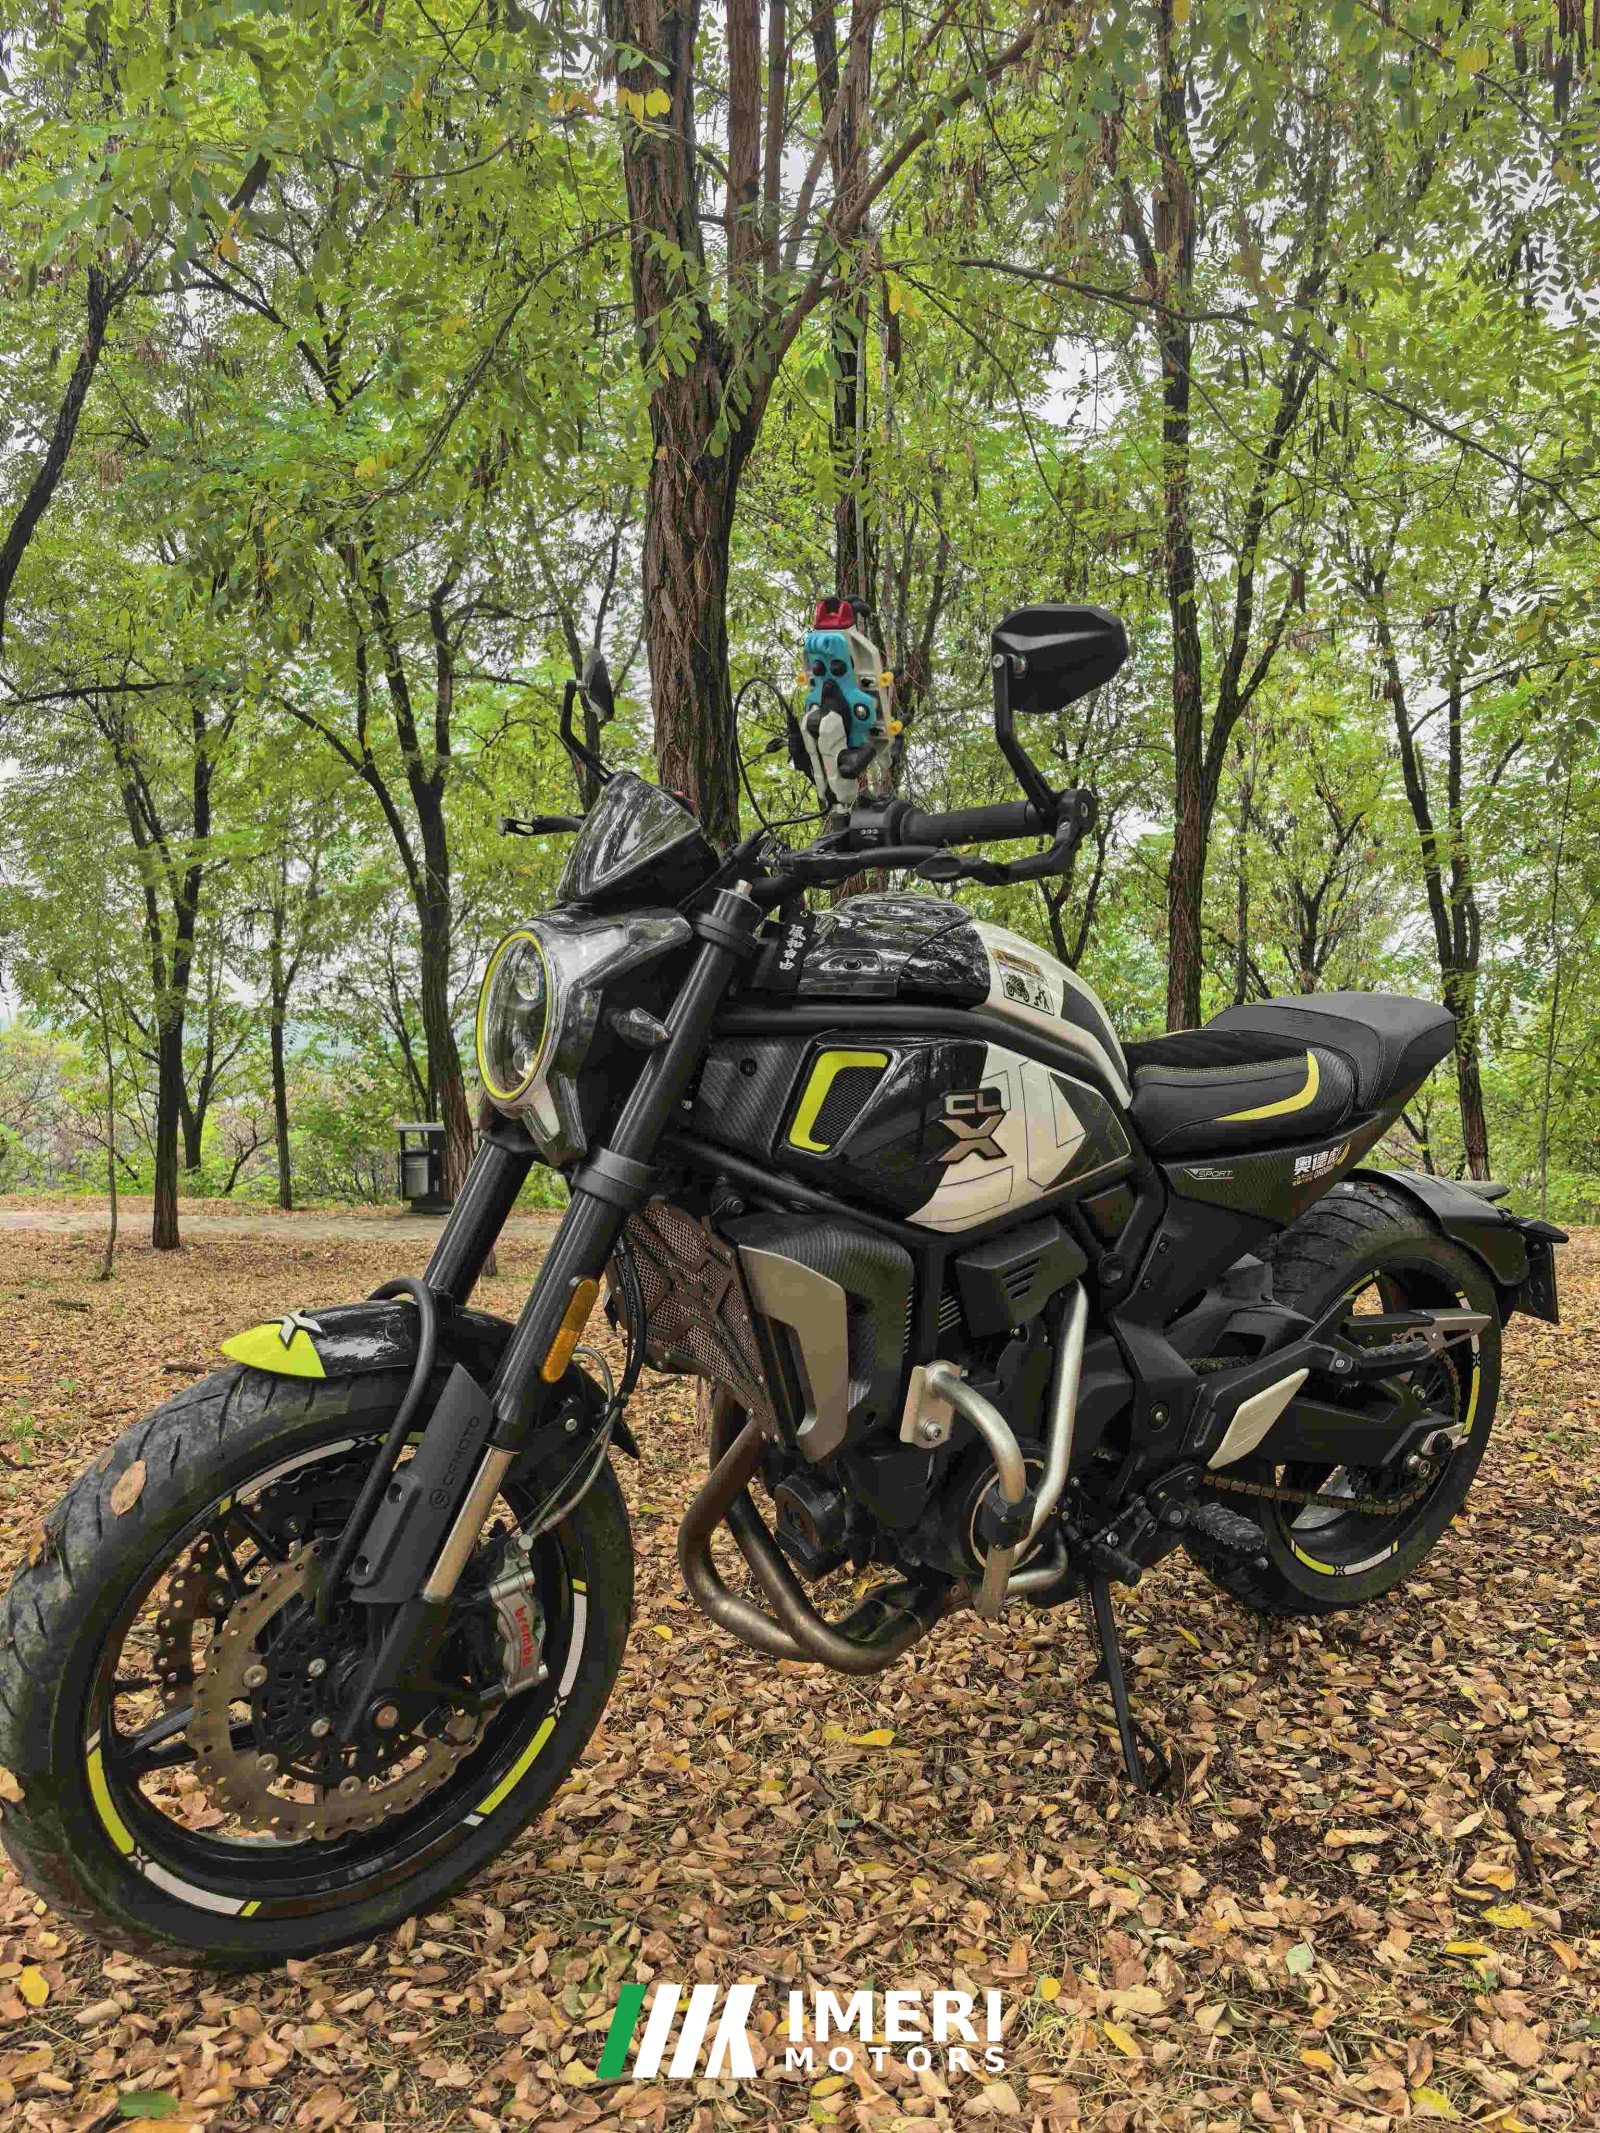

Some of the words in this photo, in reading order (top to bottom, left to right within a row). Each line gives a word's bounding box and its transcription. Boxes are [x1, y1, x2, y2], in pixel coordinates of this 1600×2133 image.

[944, 1093, 1002, 1115] CL
[1198, 1170, 1234, 1179] SPORT
[514, 1605, 533, 1667] brembo
